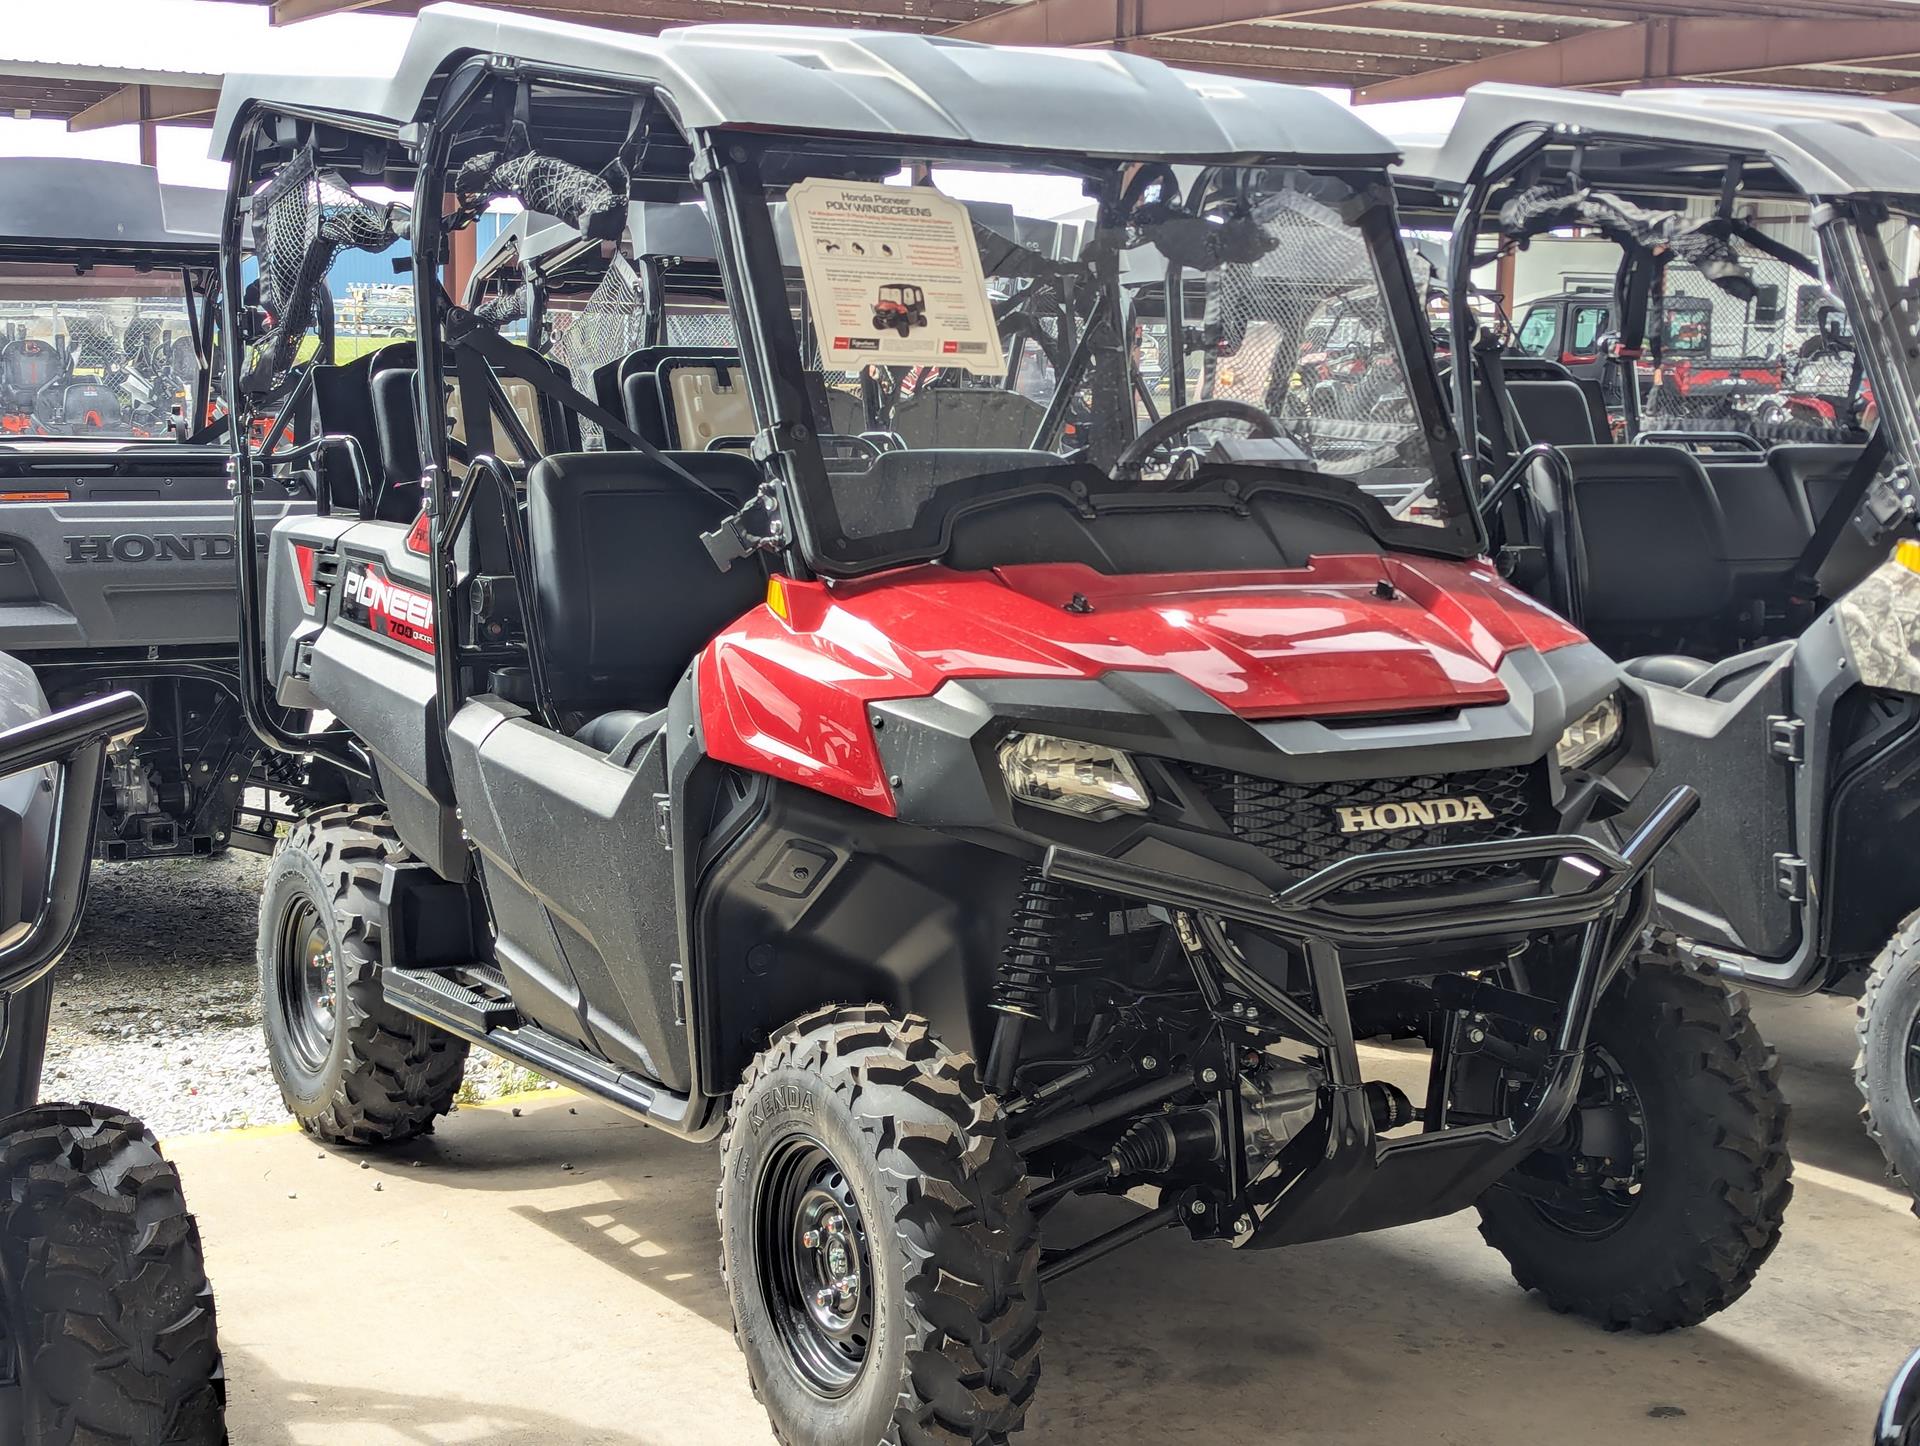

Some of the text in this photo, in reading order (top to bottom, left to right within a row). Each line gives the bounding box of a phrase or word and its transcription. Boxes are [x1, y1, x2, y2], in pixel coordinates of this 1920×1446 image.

[826, 201, 855, 211] POLY
[855, 203, 932, 217] WINDSCREENS
[841, 192, 911, 206] Honda Pioneer
[63, 533, 270, 563] HOND
[390, 620, 413, 638] 700
[1335, 795, 1495, 833] HONDA
[748, 1084, 815, 1136] KENDA
